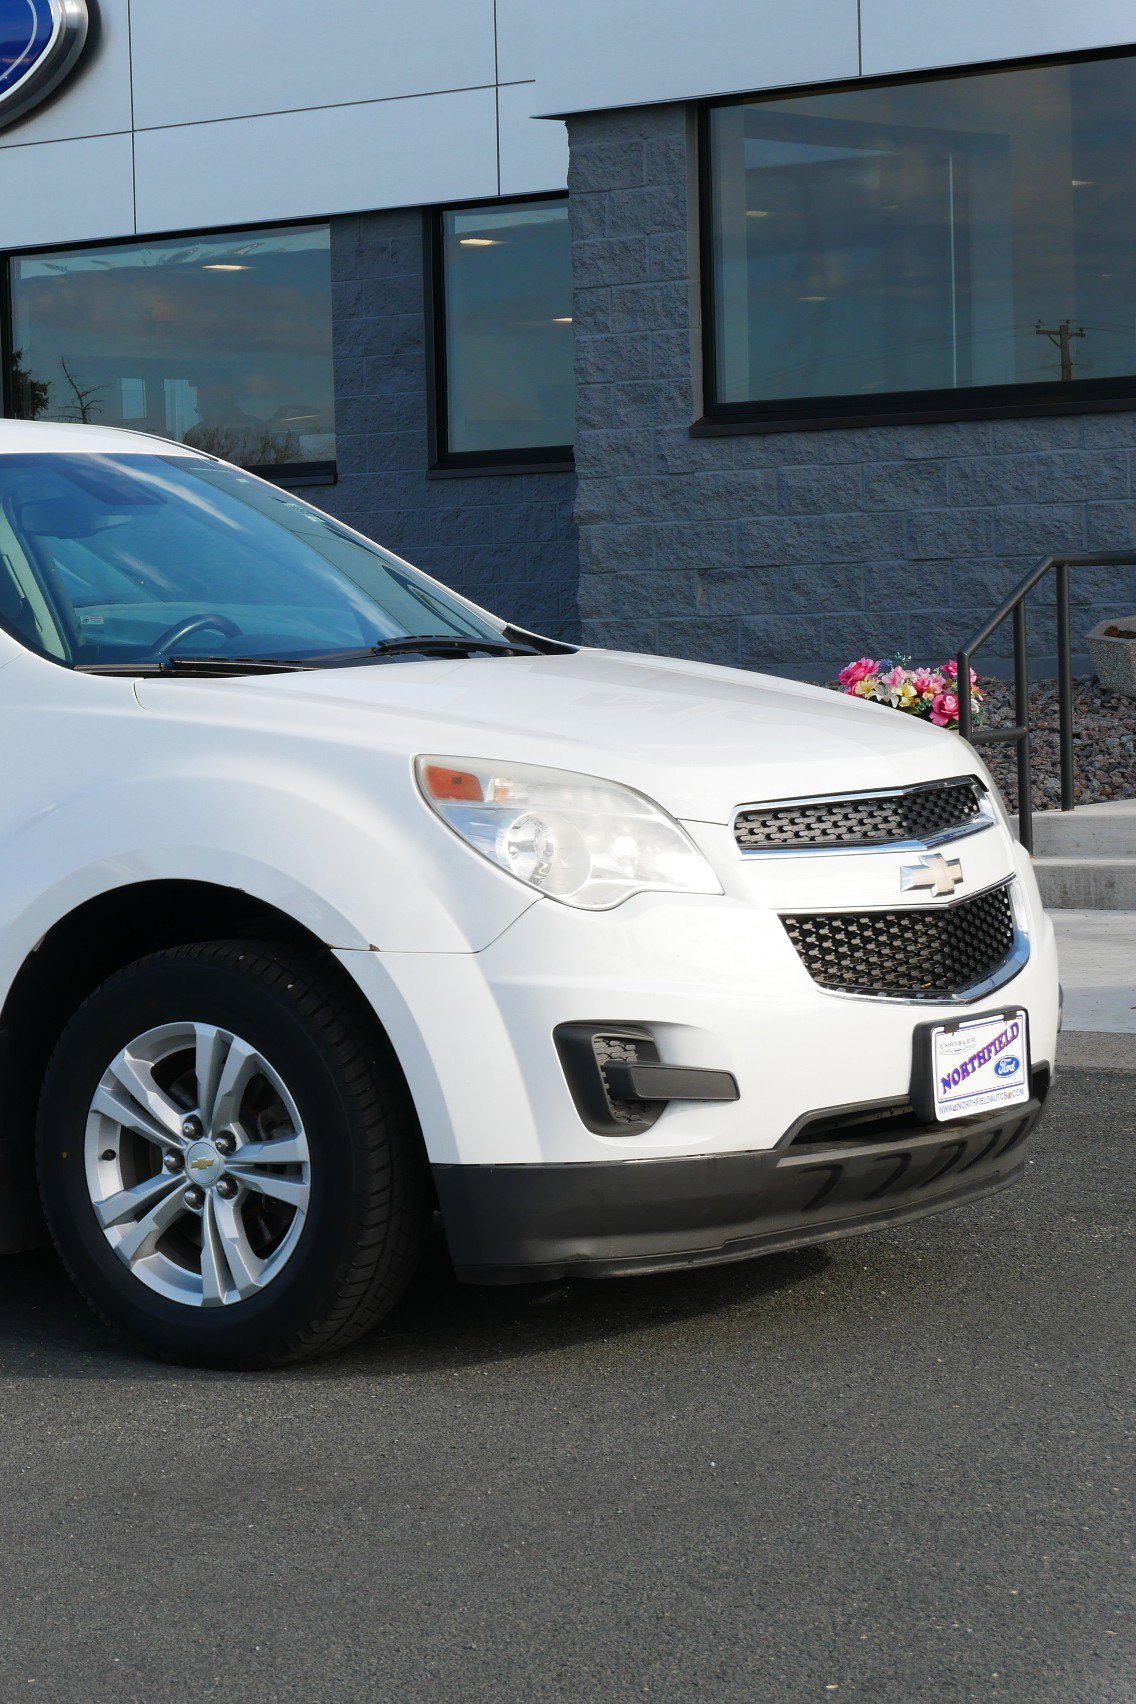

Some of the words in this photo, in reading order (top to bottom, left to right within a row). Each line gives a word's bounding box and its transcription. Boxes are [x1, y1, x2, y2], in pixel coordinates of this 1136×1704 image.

[940, 1037, 976, 1049] CHRYSLER
[940, 1022, 1019, 1094] NORTHFIELD
[998, 1059, 1016, 1074] Ford
[938, 1088, 1024, 1114] WWWNORTHFIELDAUTOSCOM
